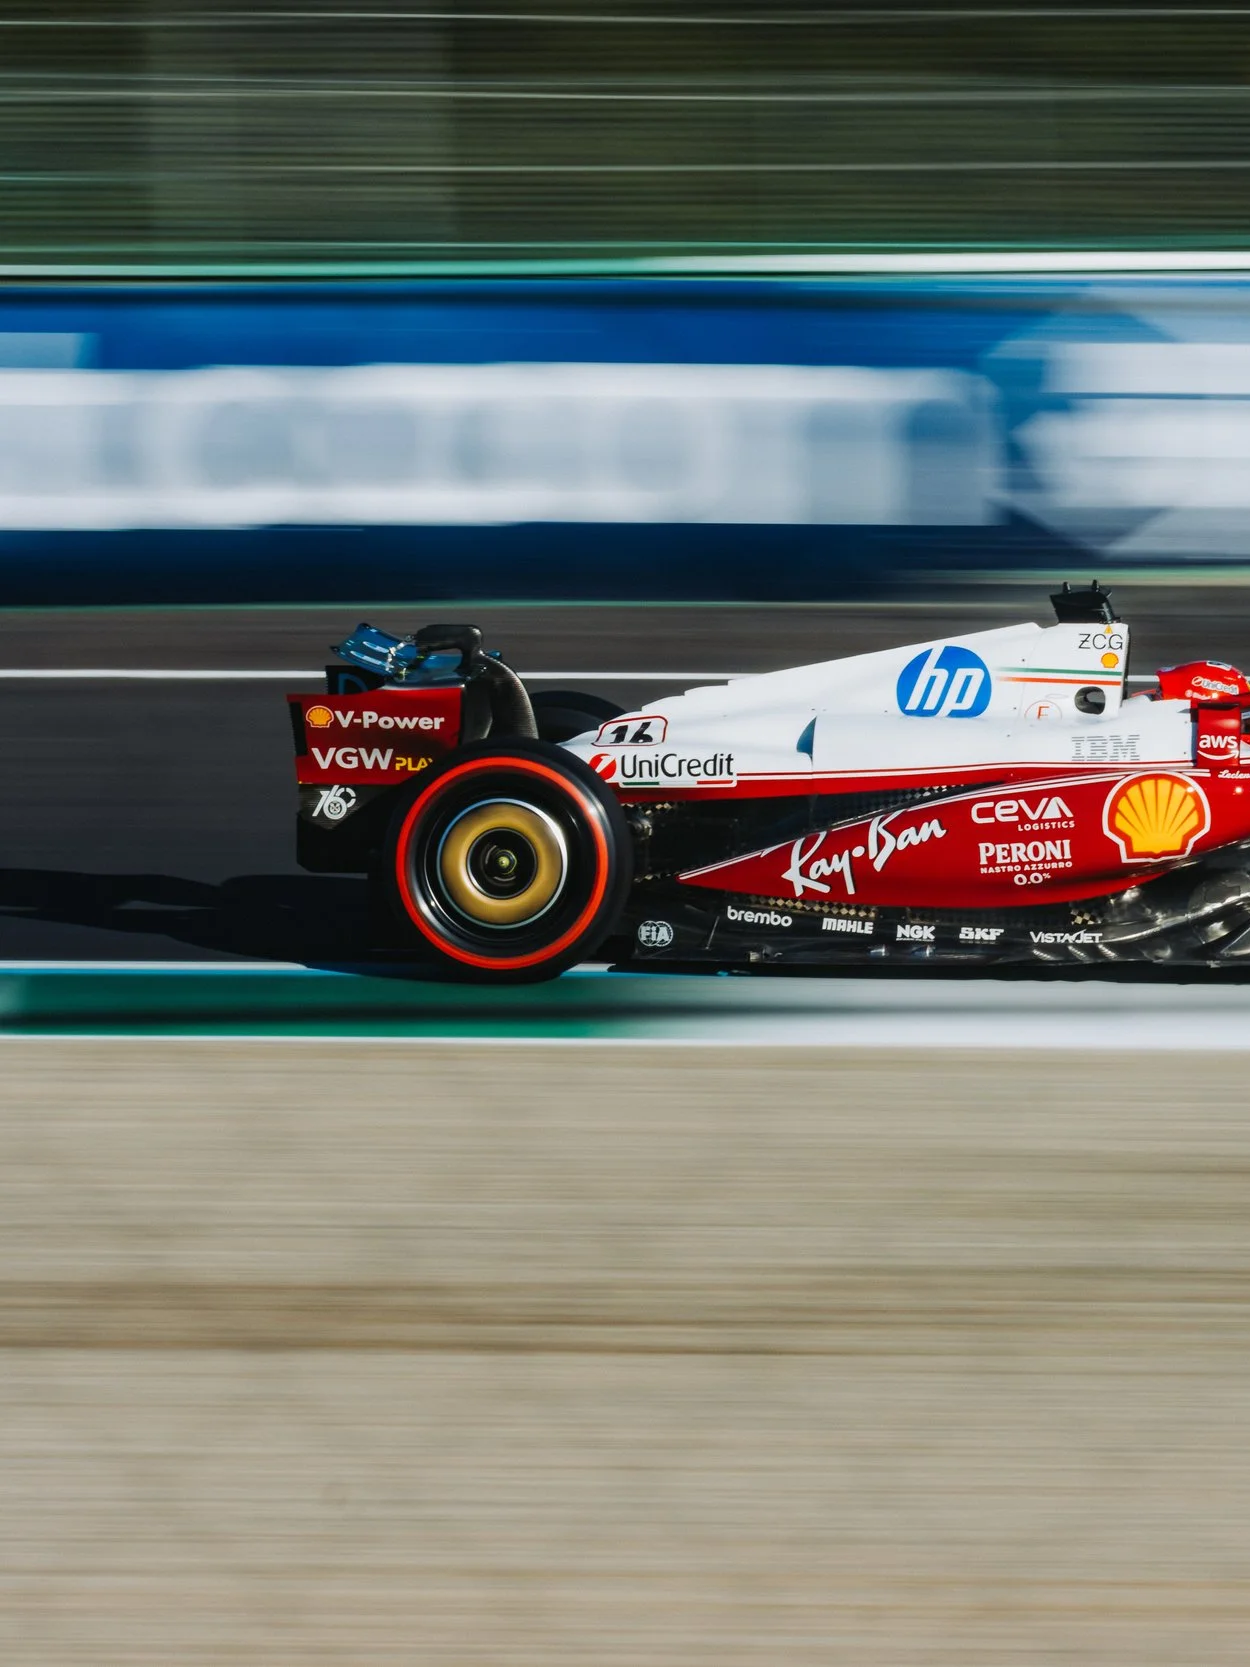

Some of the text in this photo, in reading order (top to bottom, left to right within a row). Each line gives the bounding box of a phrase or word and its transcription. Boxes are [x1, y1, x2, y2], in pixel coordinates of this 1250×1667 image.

[1078, 633, 1123, 650] ZCG
[905, 646, 985, 717] hp
[334, 710, 445, 730] V-Power
[610, 722, 654, 744] 16
[1199, 734, 1238, 749] aws
[1071, 734, 1140, 761] IBM
[311, 747, 433, 771] VGW PLA
[621, 753, 734, 778] UniCredit
[1018, 820, 1075, 831] LOGISTICS
[978, 839, 1072, 865] PERONI
[980, 861, 1073, 874] NASTRO AZZURRO
[1013, 872, 1051, 885] 0.0%
[727, 906, 793, 927] brembo
[822, 917, 874, 934] MAHLE
[896, 924, 936, 939] NGK
[959, 927, 1004, 941] SKF
